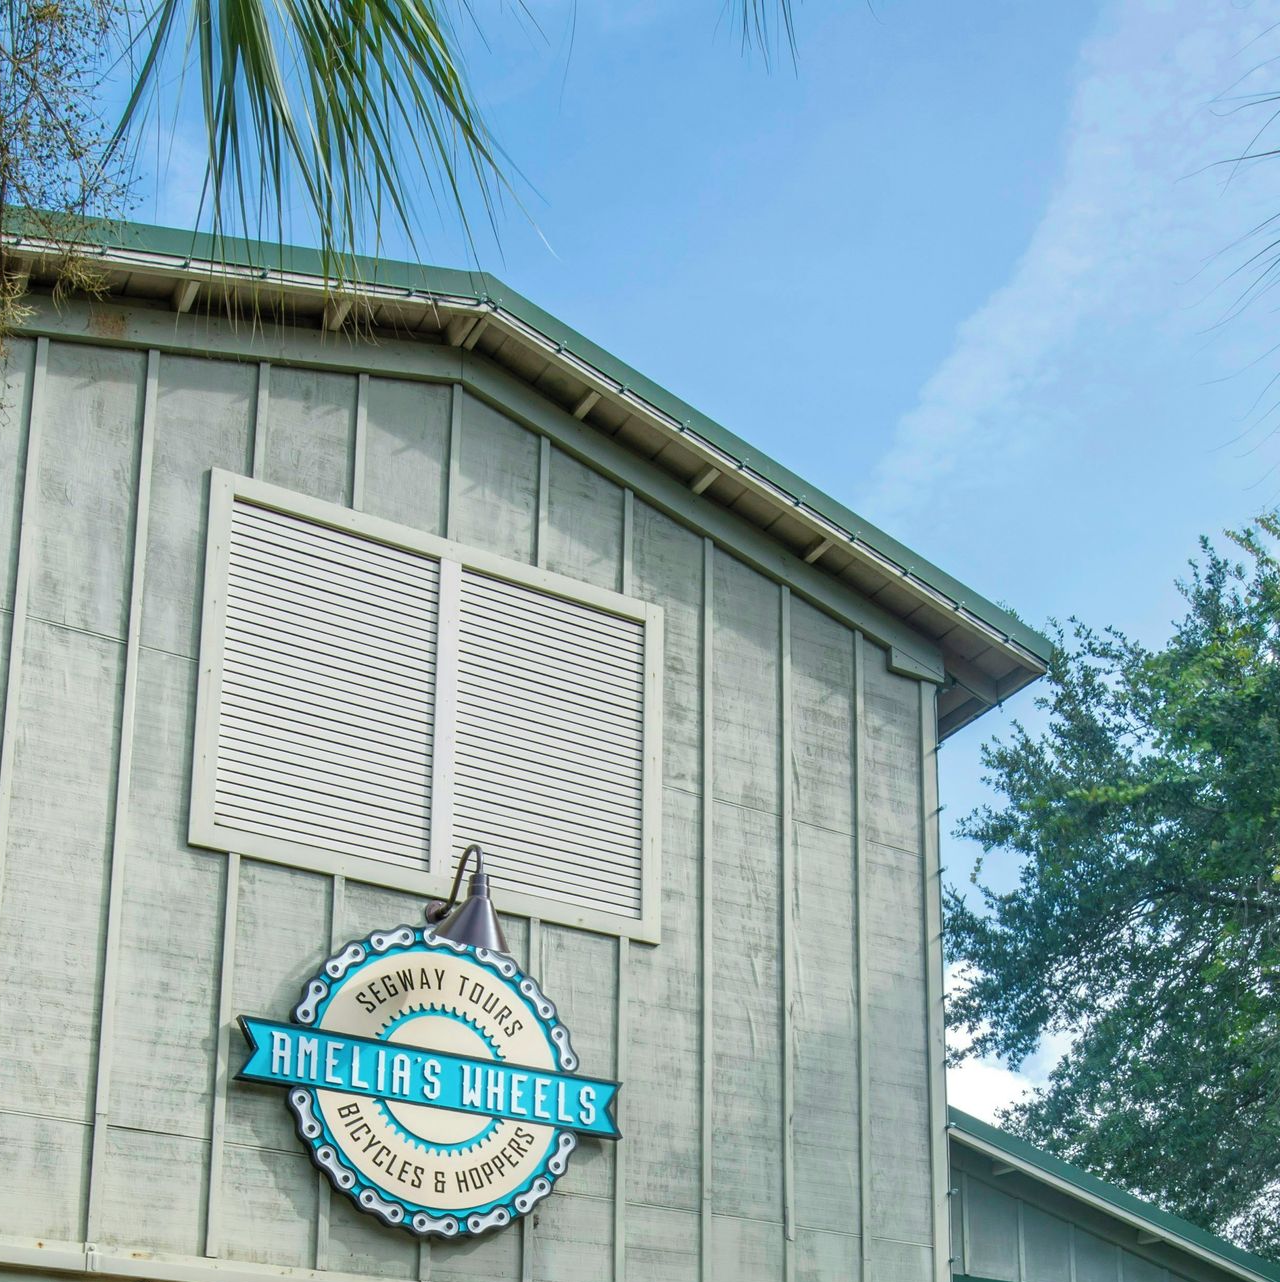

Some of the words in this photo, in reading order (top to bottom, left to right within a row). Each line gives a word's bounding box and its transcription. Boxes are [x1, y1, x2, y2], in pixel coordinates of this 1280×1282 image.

[355, 968, 446, 1014] SEGWAY
[459, 975, 524, 1038] TOURS
[461, 1064, 597, 1125] WHEELS
[337, 1101, 425, 1190] BICYCLES
[434, 1170, 446, 1194] &
[457, 1126, 535, 1194] HOPPERS
